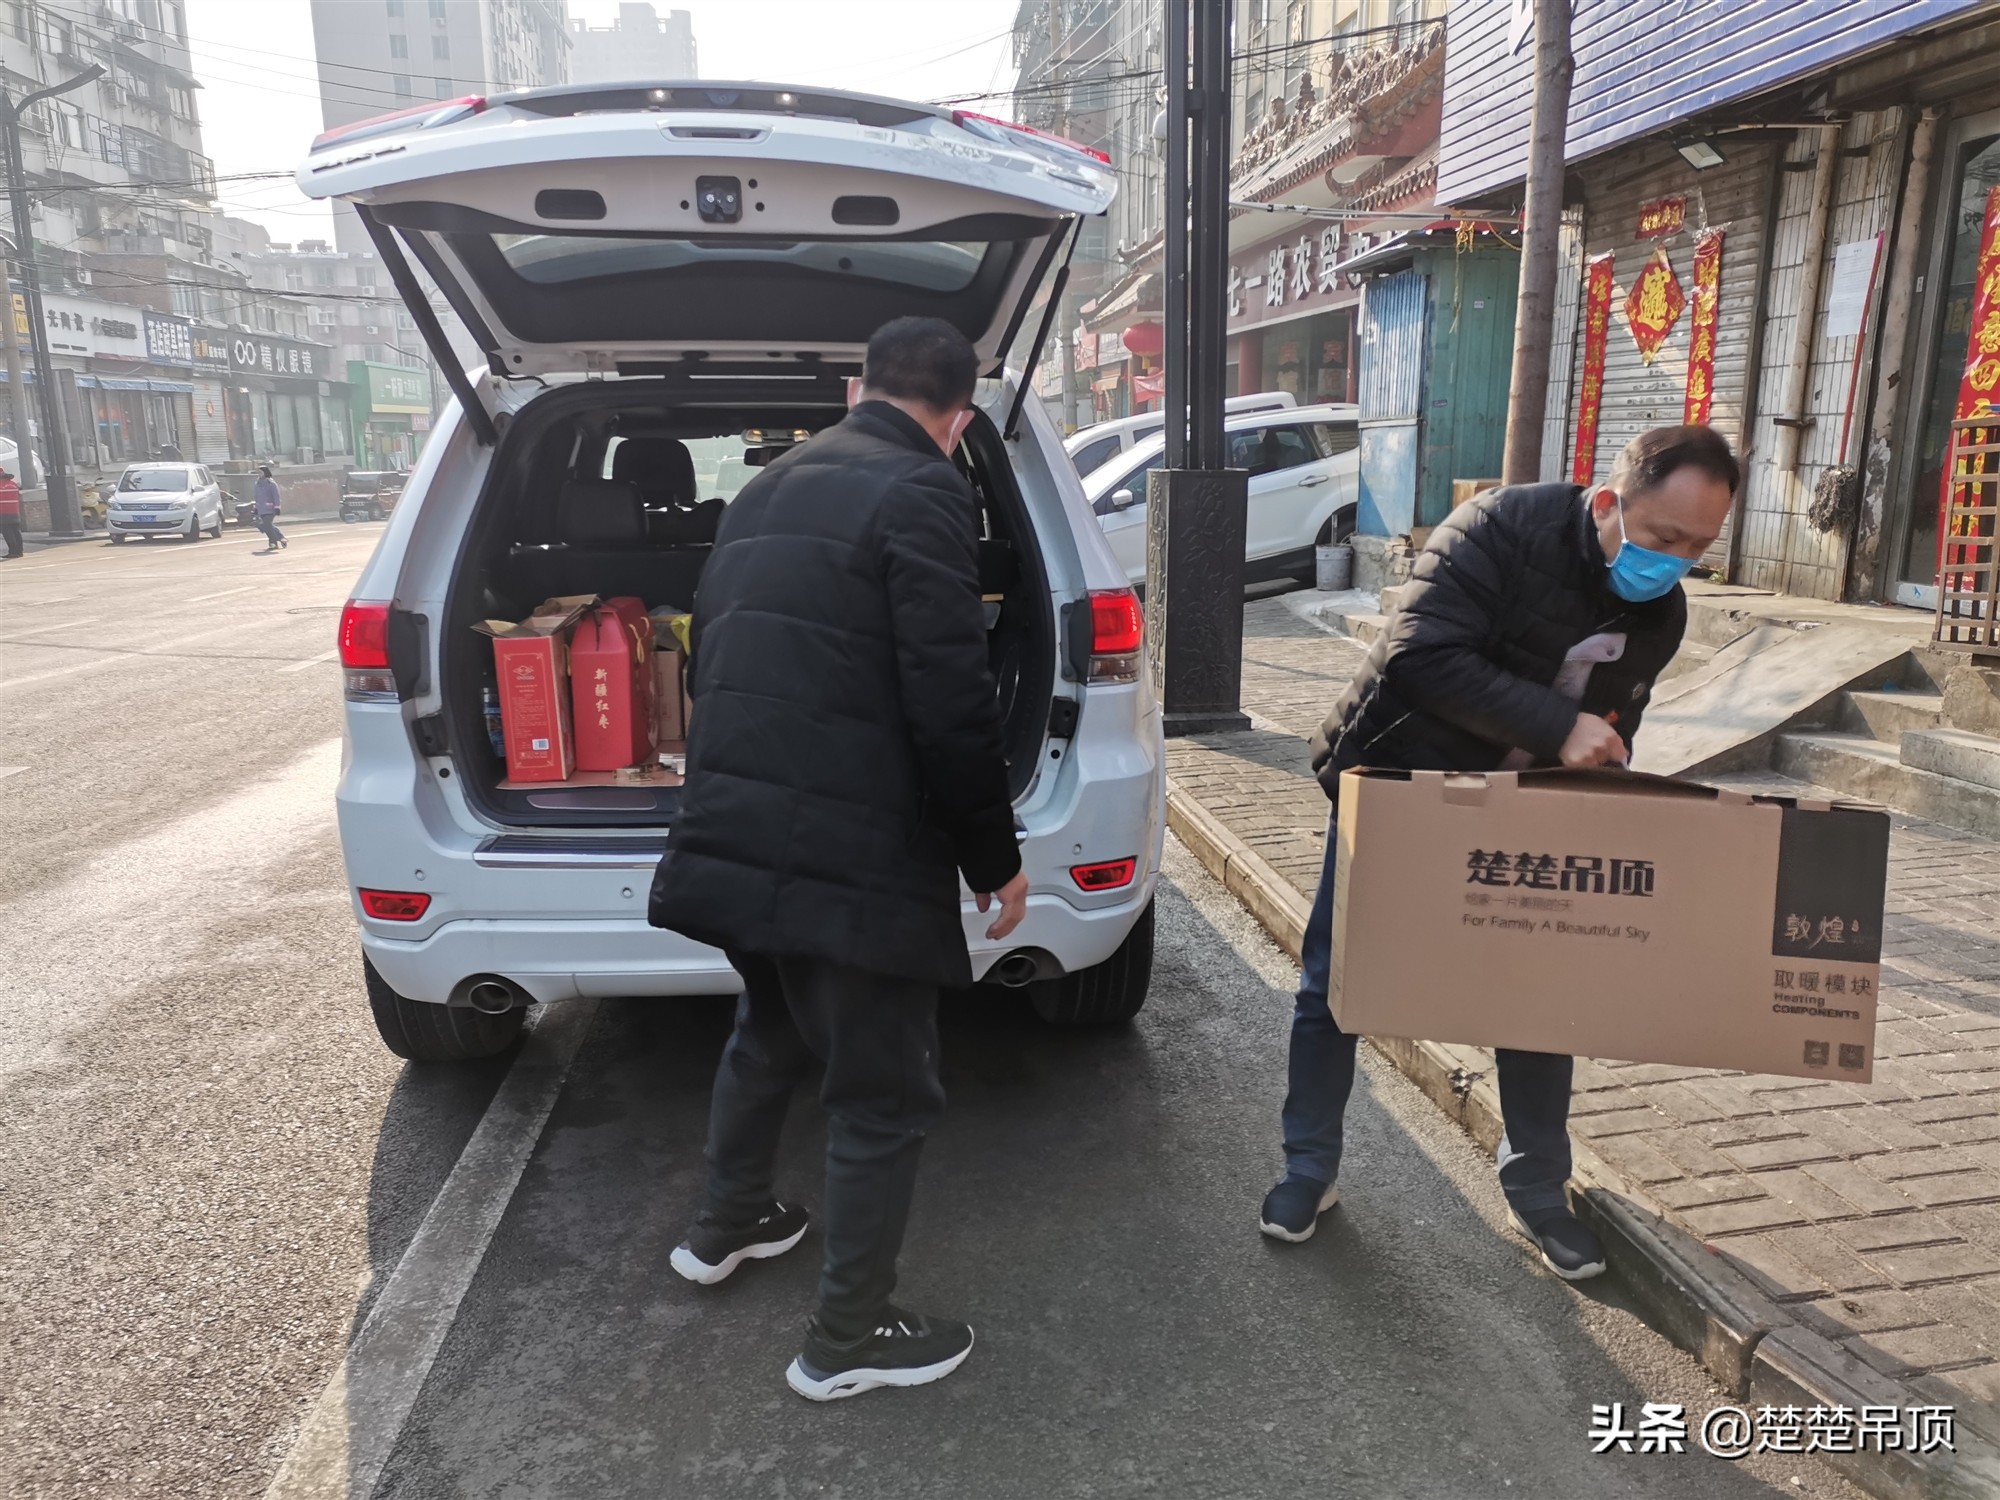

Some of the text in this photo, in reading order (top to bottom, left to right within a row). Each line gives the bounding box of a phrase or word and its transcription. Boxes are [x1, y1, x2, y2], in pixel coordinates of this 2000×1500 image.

[1227, 222, 1405, 317] 七一路农贸市
[260, 343, 313, 375] 精仪眼镜
[594, 667, 610, 729] 新疆红枣
[1466, 848, 1655, 898] 楚楚吊顶
[1462, 913, 1651, 943] For Family A Beautiful Sky
[1784, 913, 1846, 950] 敦煌
[1774, 969, 1873, 997] 取暖模块
[1772, 1003, 1860, 1021] COMPONENTS
[1773, 992, 1826, 1008] Heating
